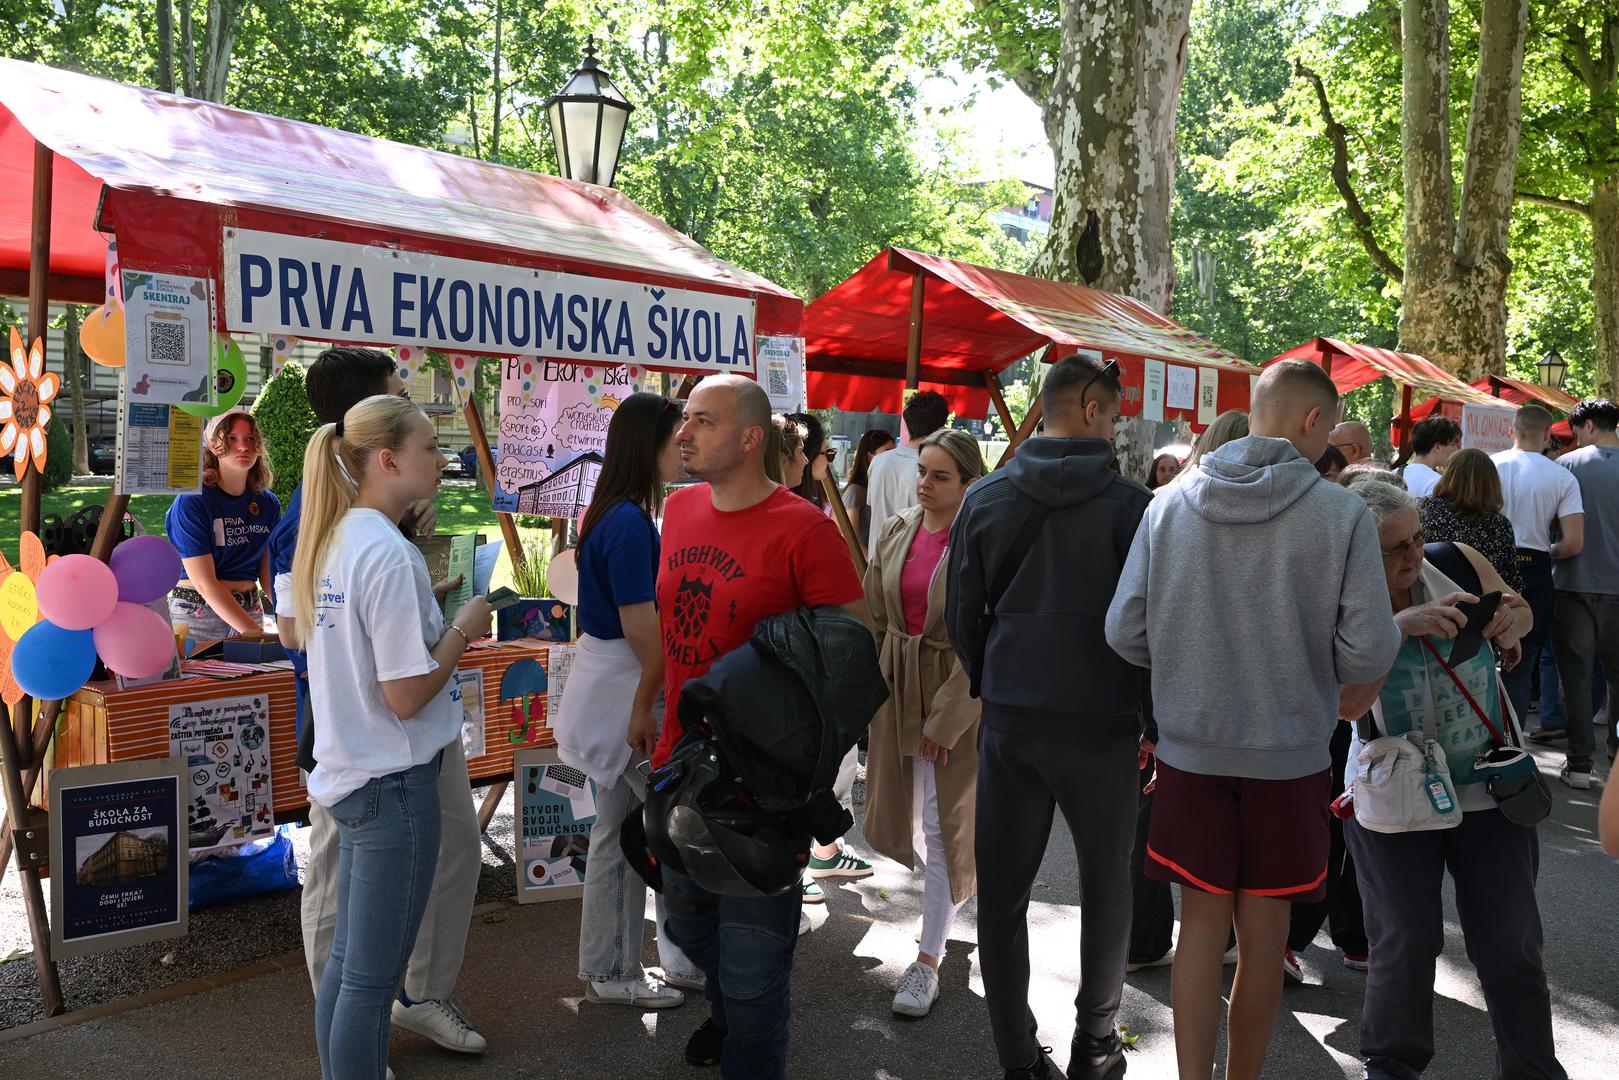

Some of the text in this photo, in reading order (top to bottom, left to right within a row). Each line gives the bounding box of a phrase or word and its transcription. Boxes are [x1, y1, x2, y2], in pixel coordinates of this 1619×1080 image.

[143, 291, 191, 305] SKENIRAJ
[240, 253, 750, 366] PRVA EKONOMSKA ŠKOLA
[667, 545, 746, 582] HIGHWAY
[93, 806, 148, 819] ŠKOLA ZA
[522, 804, 564, 815] STVORI
[522, 815, 560, 826] SVOJU
[522, 823, 592, 836] BUDUĆNOST
